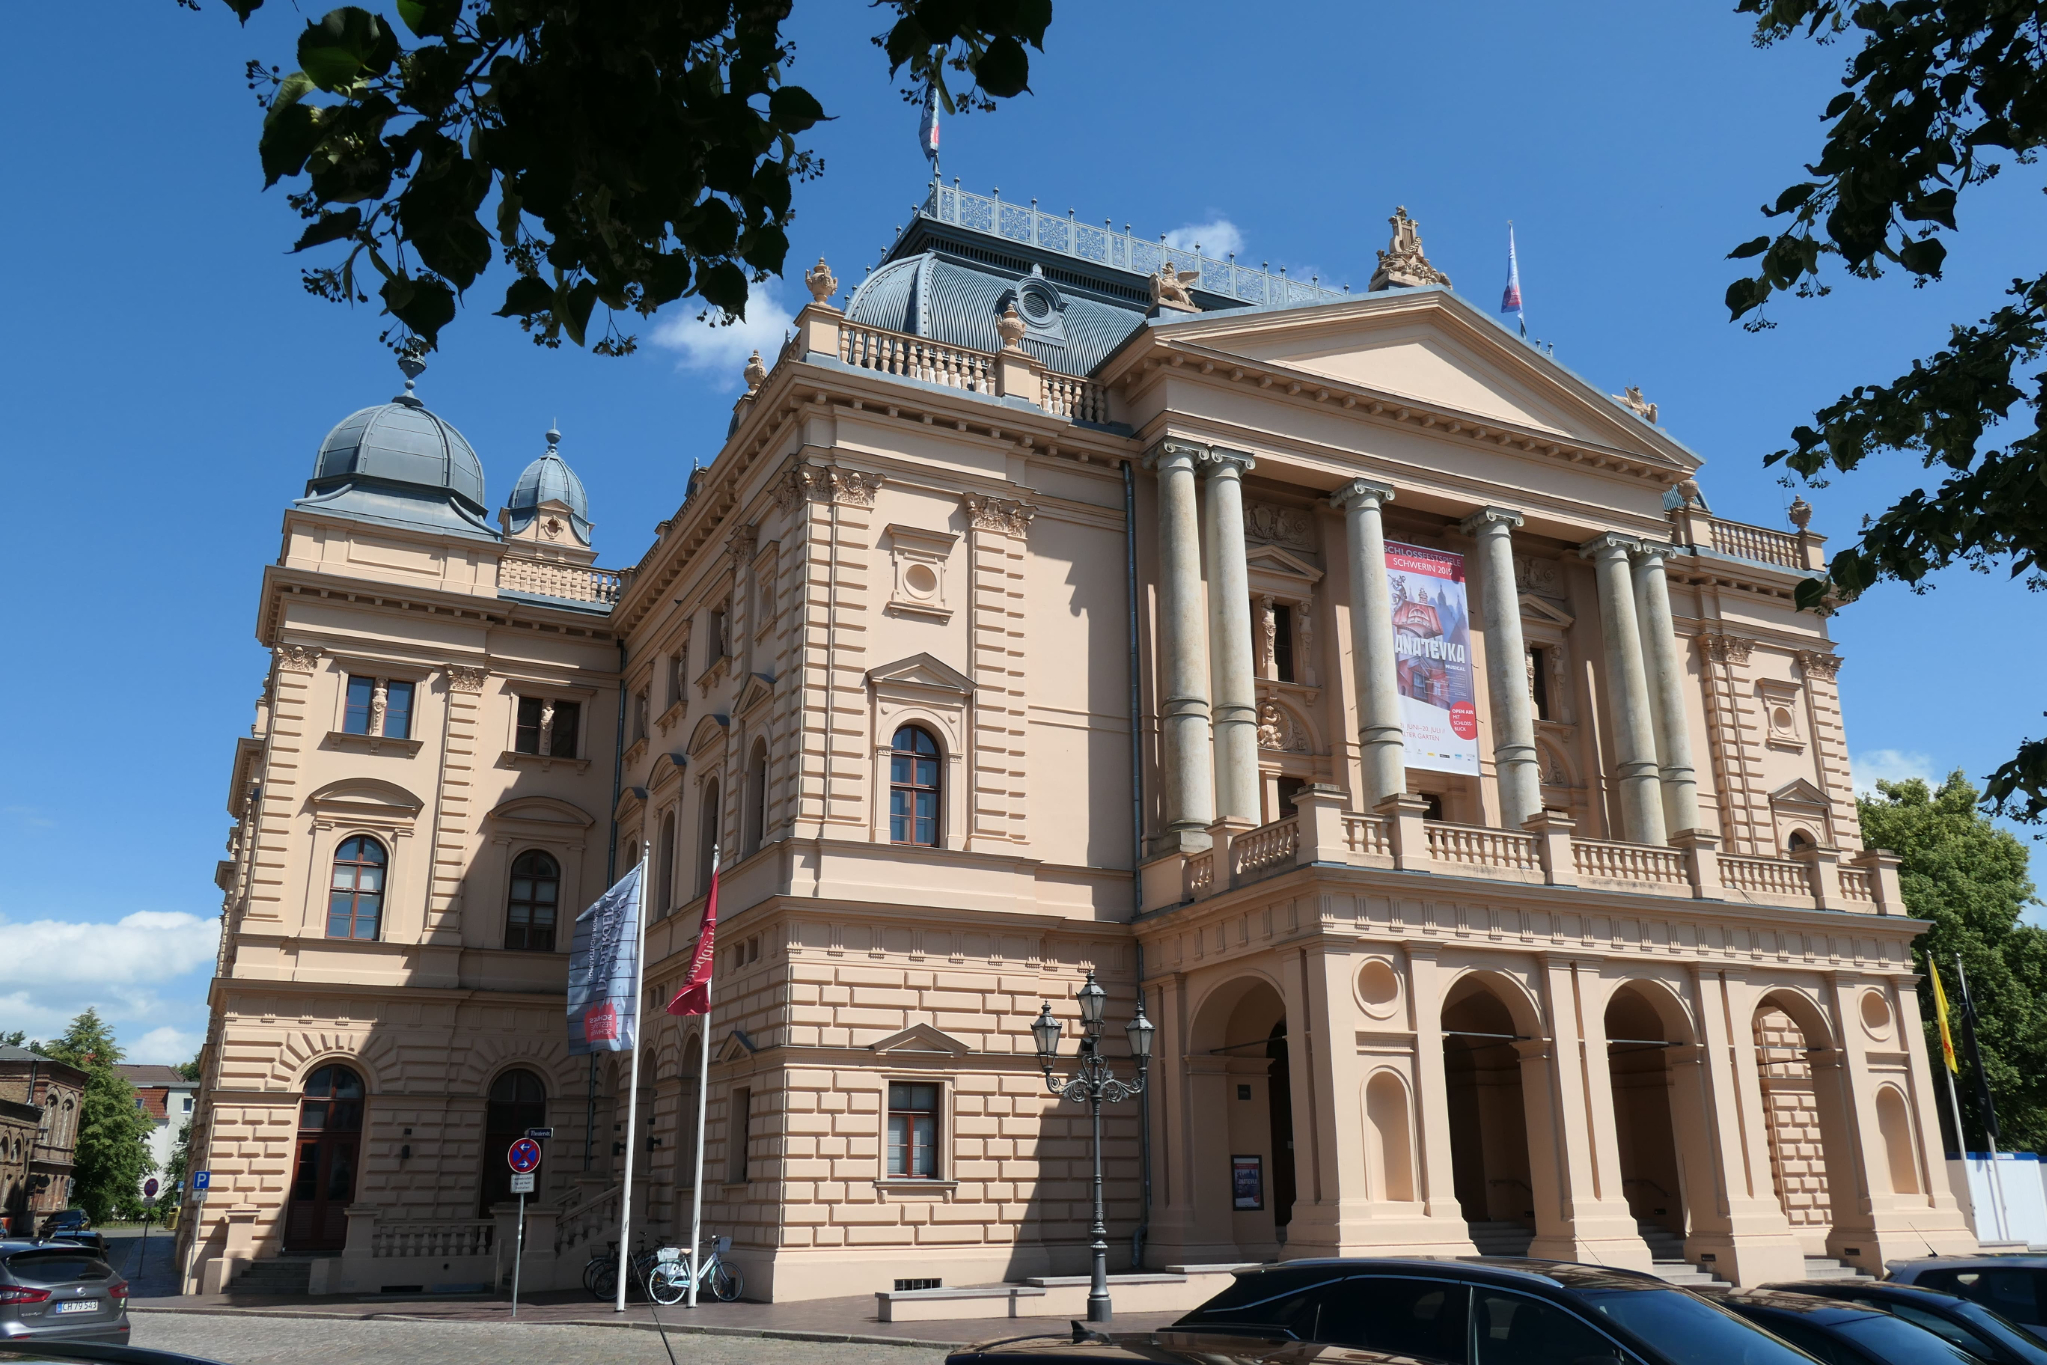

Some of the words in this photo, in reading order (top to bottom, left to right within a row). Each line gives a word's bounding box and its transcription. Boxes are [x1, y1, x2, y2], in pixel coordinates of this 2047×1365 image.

[1384, 545, 1461, 567] SCHLOSSFESTSPIELE
[1393, 557, 1436, 573] SCHWERIN
[1437, 565, 1453, 576] 2019
[1394, 634, 1466, 664] ANATEVKA
[1445, 664, 1466, 672] MUSICAL
[197, 1173, 207, 1187] P
[62, 1302, 73, 1311] CH
[74, 1302, 82, 1310] 79
[84, 1301, 97, 1309] 543
